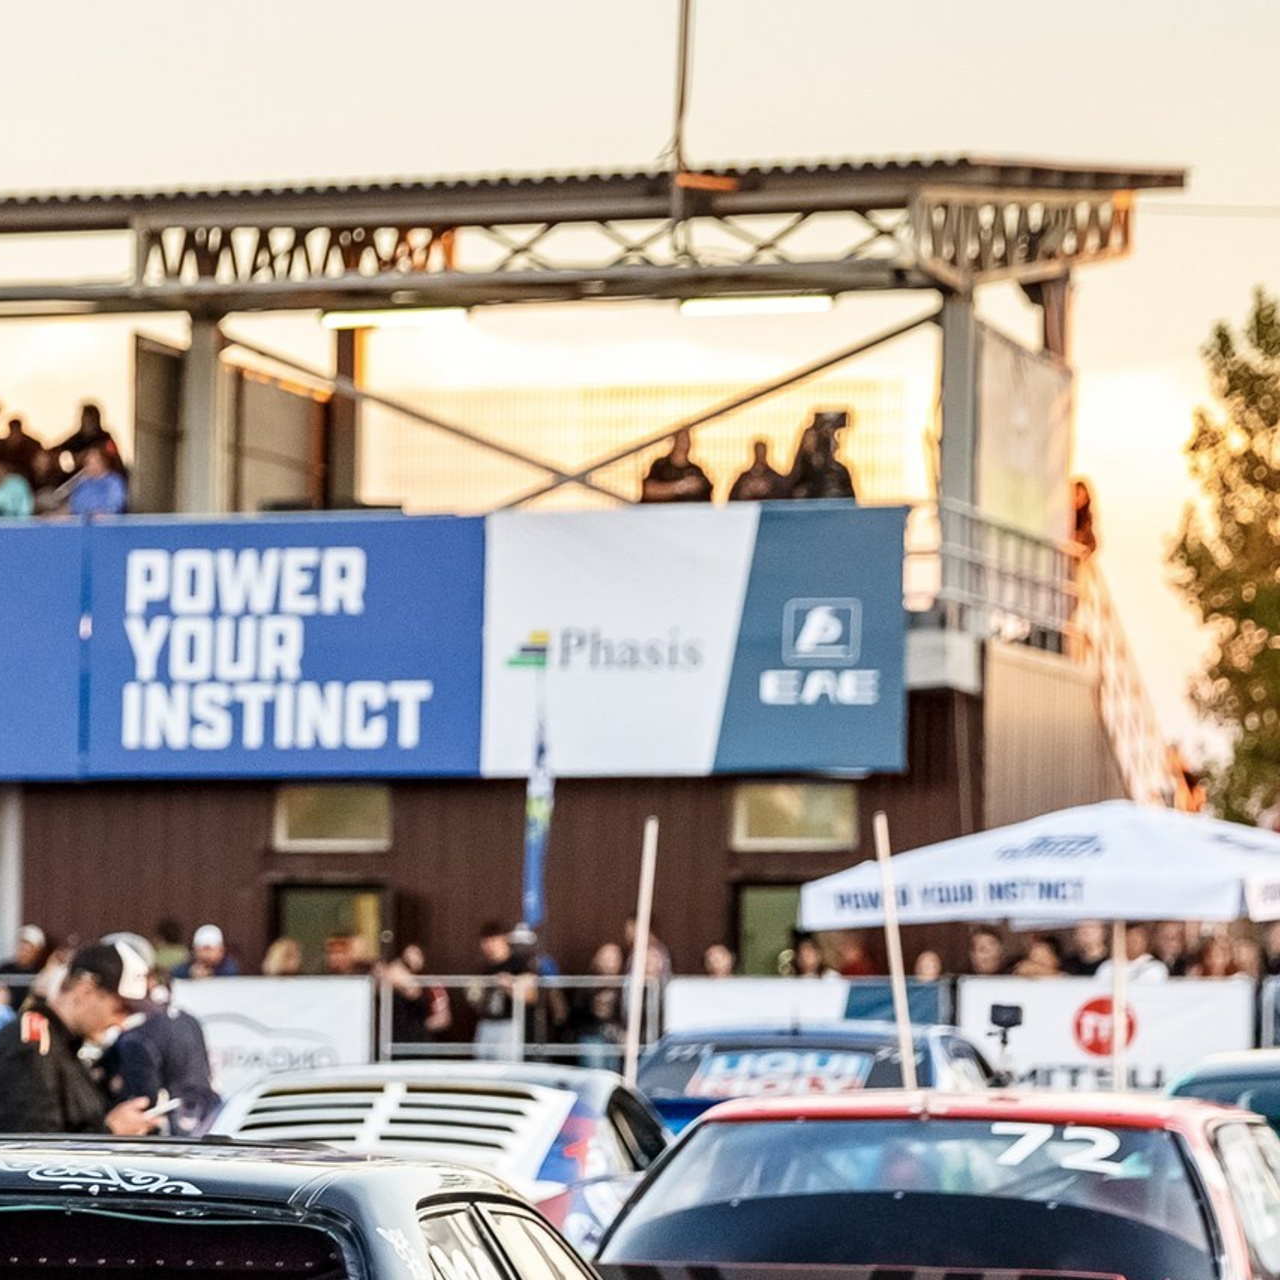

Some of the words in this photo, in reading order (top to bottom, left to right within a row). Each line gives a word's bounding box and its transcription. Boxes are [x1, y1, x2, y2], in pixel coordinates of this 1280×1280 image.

[124, 546, 368, 616] POWER
[123, 614, 305, 682] YOUR
[558, 626, 705, 669] Phasis
[120, 679, 434, 751] INSTINCT
[759, 669, 880, 705] EAE
[990, 1122, 1122, 1175] 72
